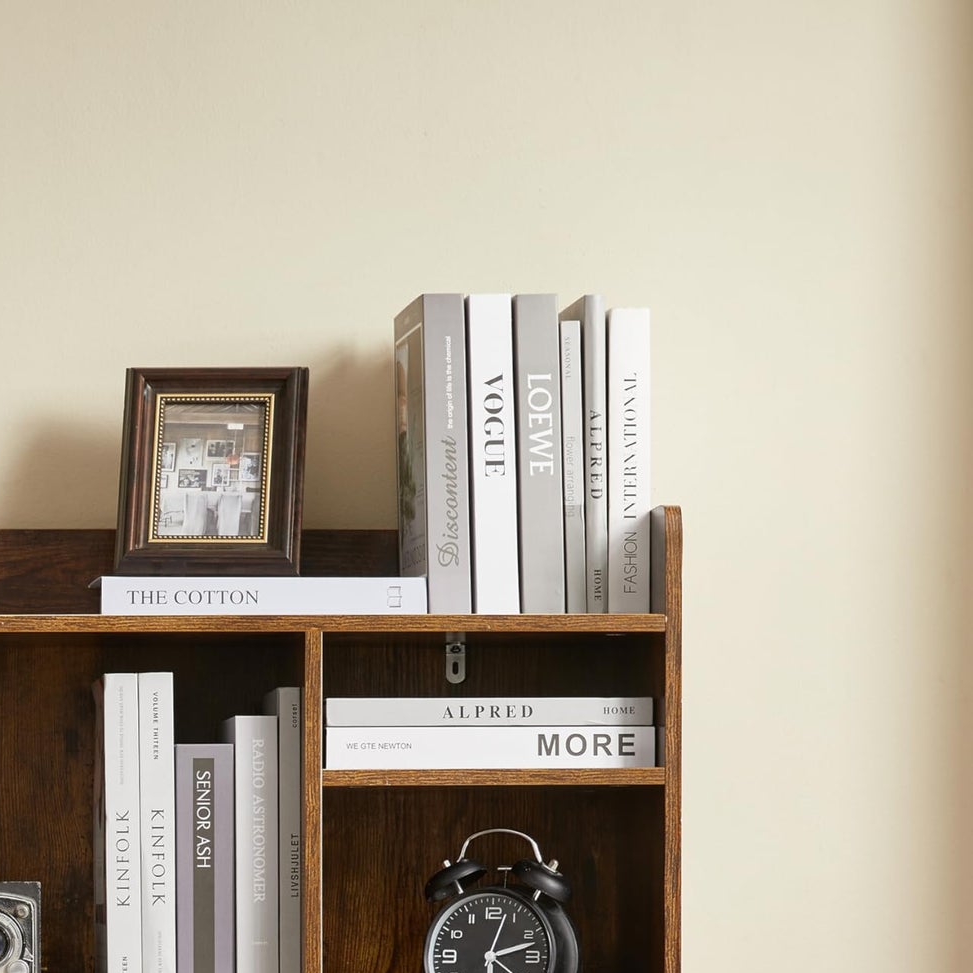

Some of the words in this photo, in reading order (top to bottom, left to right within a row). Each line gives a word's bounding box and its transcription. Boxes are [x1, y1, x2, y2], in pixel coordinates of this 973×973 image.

[444, 336, 452, 363] chemical
[483, 373, 506, 477] VOGUE
[527, 373, 554, 476] LOEWE
[566, 436, 575, 466] flower
[590, 410, 603, 500] ALPRED
[623, 373, 637, 519] INTERNATIONAL
[438, 436, 460, 567] Discontent
[565, 470, 576, 518] arranging
[623, 531, 637, 594] FASHION
[127, 590, 168, 605] THE
[174, 590, 259, 605] COTTON
[593, 569, 602, 601] HOME
[443, 705, 534, 719] ALPRED
[603, 706, 636, 715] HOME
[537, 733, 636, 756] MORE
[252, 738, 265, 789] RADIO
[196, 770, 211, 830] SENIOR
[116, 810, 130, 906] KINFOLK
[151, 809, 165, 906] KINFOLK
[196, 836, 211, 868] ASH
[252, 794, 266, 903] ASTRONOMER
[290, 833, 299, 898] LIVSHJULET
[468, 914, 475, 924] 11
[485, 906, 503, 920] 12
[512, 912, 516, 923] 1
[451, 930, 463, 940] 10
[524, 930, 534, 939] 2
[442, 949, 457, 964] 9
[525, 951, 540, 964] 3
